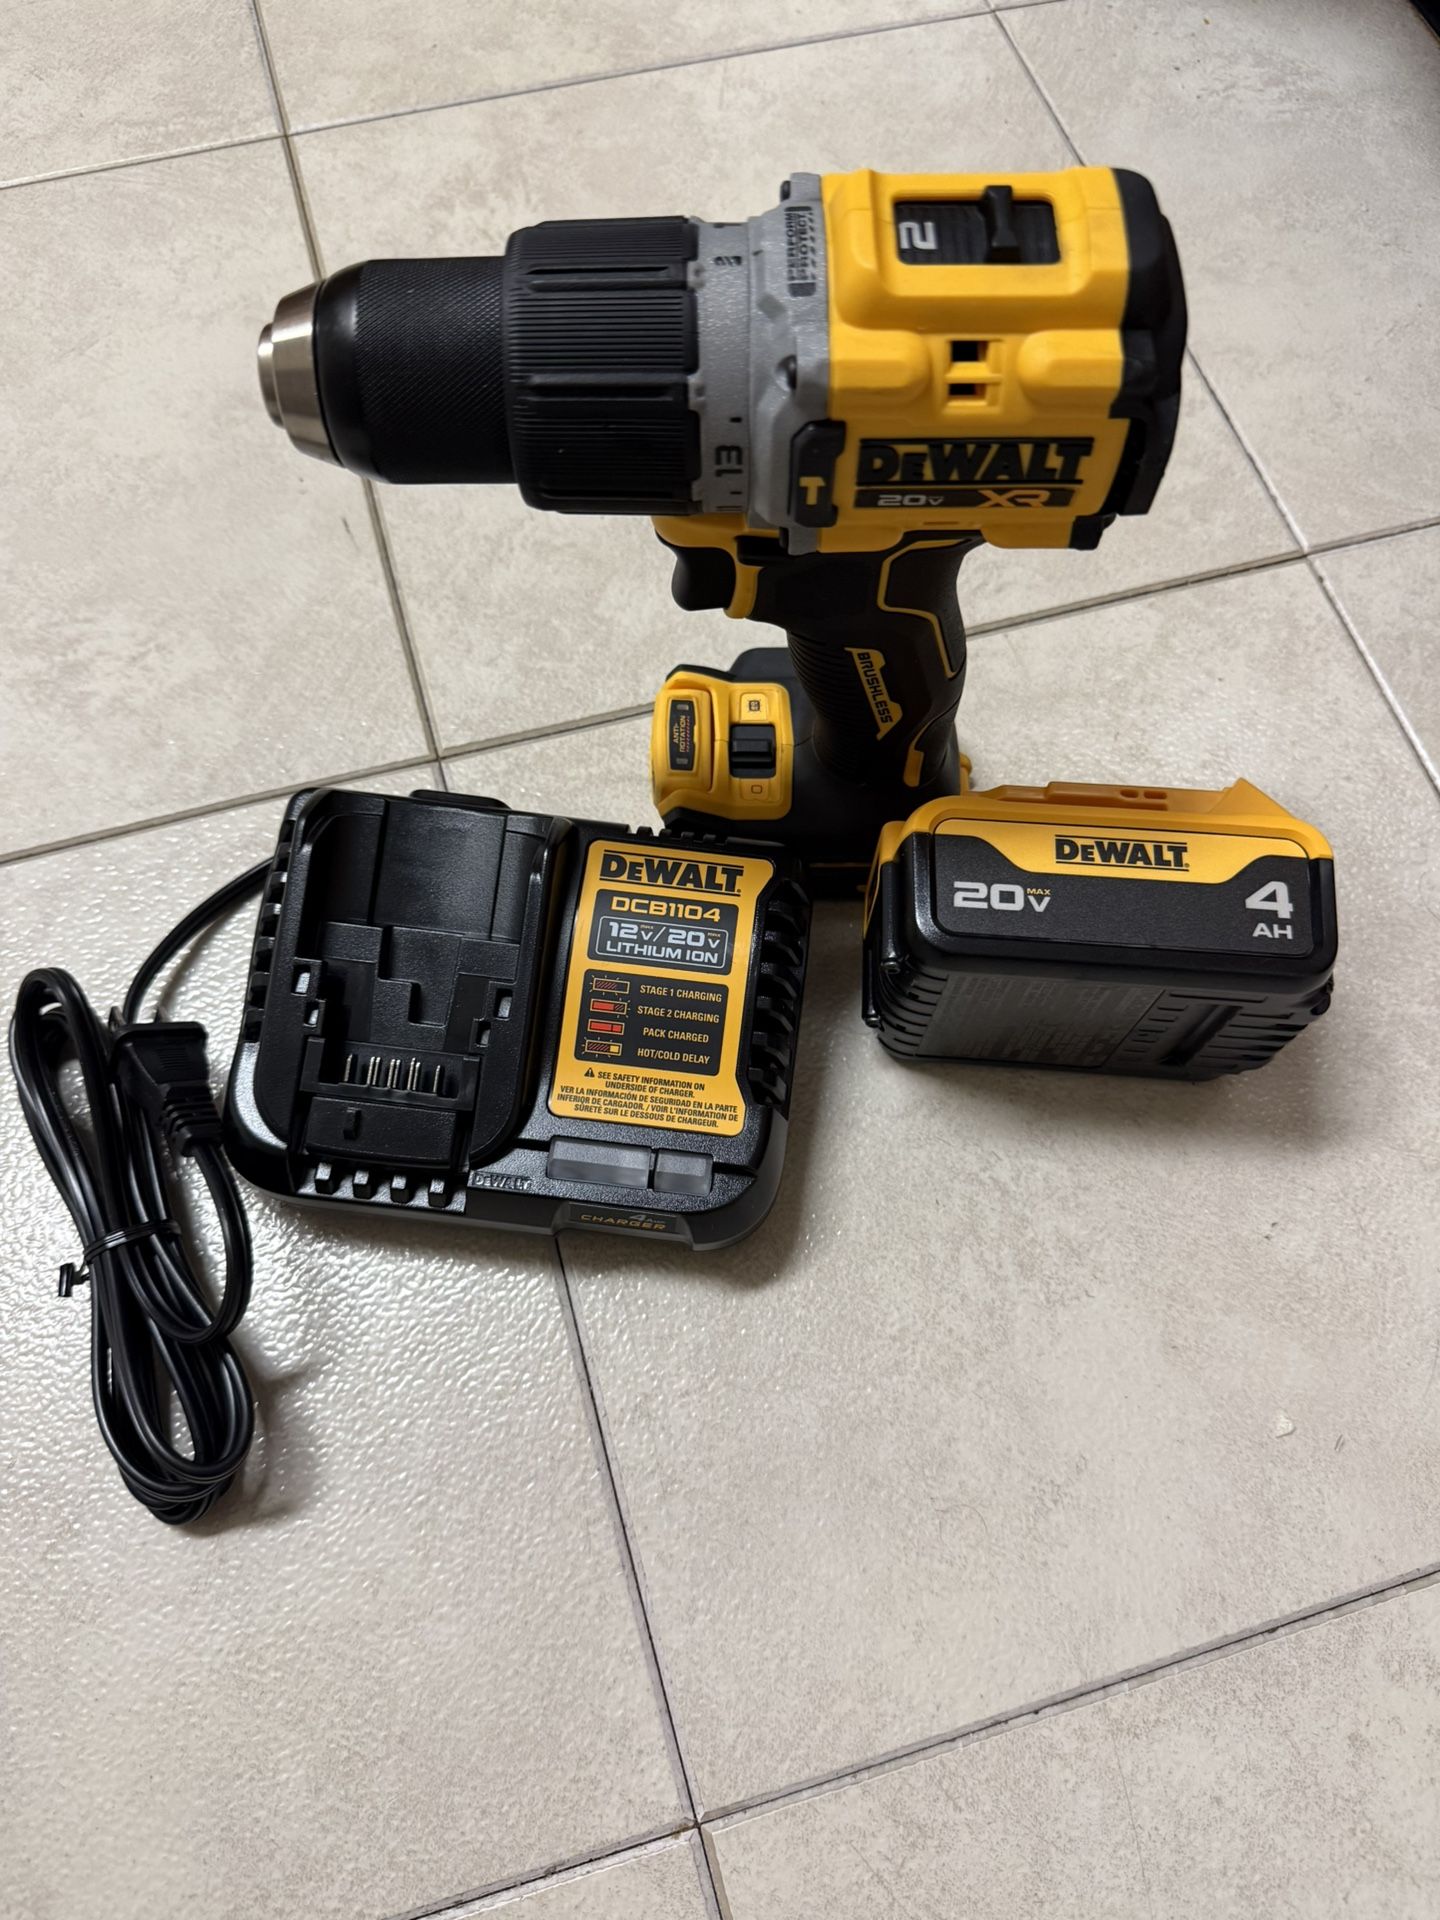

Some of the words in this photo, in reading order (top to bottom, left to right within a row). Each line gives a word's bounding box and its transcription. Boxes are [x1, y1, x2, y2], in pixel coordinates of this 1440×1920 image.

[899, 221, 938, 250] 2
[715, 445, 743, 477] 13
[976, 489, 1050, 508] XR
[857, 652, 893, 723] BRUSHLESS
[610, 896, 721, 922] DCB1104
[1245, 881, 1294, 919] 4
[1252, 922, 1293, 940] AH
[606, 941, 682, 960] LITHIUM
[685, 950, 719, 964] ION
[640, 984, 668, 996] STAGE
[670, 988, 674, 997] 1
[676, 989, 722, 1003] CHARGING
[637, 1006, 666, 1018] STAGE
[666, 1009, 672, 1018] 2
[674, 1010, 720, 1023] CHARGING
[643, 1027, 666, 1038] PACK
[668, 1030, 709, 1043] CHARGED
[637, 1048, 681, 1061] HOT/COLD
[683, 1051, 711, 1065] DELAY
[605, 1081, 647, 1092] UNDERSIDE
[660, 1087, 695, 1098] CHARGER.
[613, 1073, 640, 1082] SAFETY
[641, 1076, 693, 1089] INFORMATION
[694, 1083, 705, 1091] ON
[557, 1094, 590, 1104] INFERIOR
[603, 1099, 644, 1111] CARGADOR.
[651, 1105, 668, 1113] VOIR
[670, 1107, 726, 1120] L'INFORMATION
[728, 1114, 738, 1122] DE
[560, 1085, 574, 1093] VER
[586, 1089, 637, 1101] INFORMACIÓN
[650, 1096, 691, 1108] SEGURIDAD
[704, 1102, 713, 1110] LA
[715, 1104, 737, 1113] PARTE
[620, 1109, 629, 1117] LE
[630, 1111, 664, 1120] DESSOUS
[677, 1116, 719, 1128] CHARGEUR.
[580, 1214, 667, 1230] CHARGER
